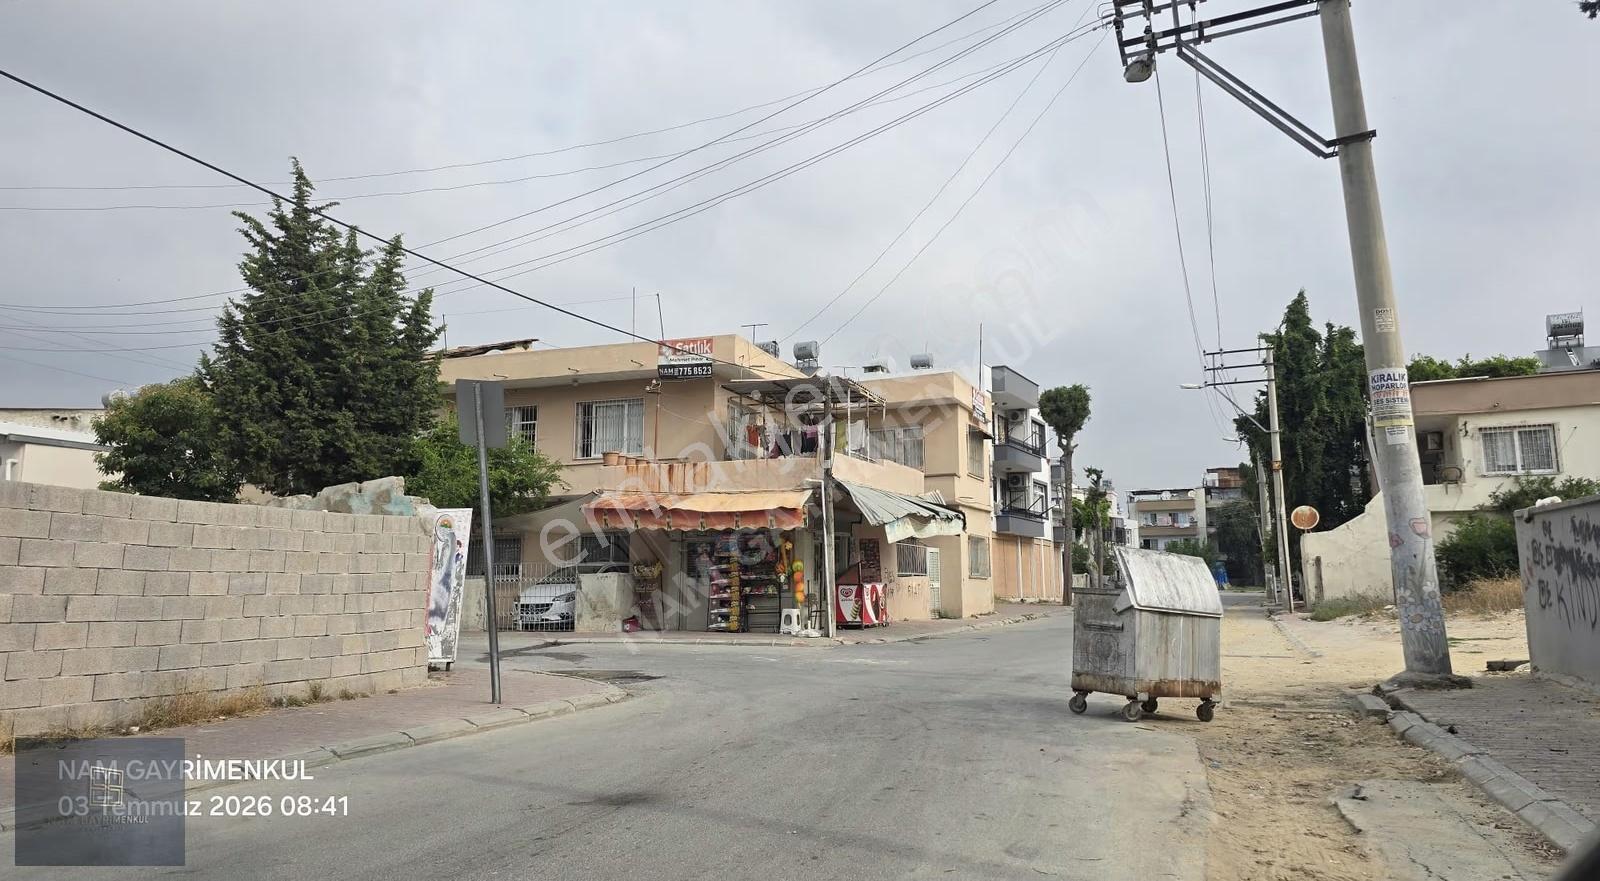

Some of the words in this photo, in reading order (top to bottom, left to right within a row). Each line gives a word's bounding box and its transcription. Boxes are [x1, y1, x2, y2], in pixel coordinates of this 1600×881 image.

[675, 340, 711, 356] Satılık
[679, 367, 692, 376] 775
[693, 366, 712, 375] 8523
